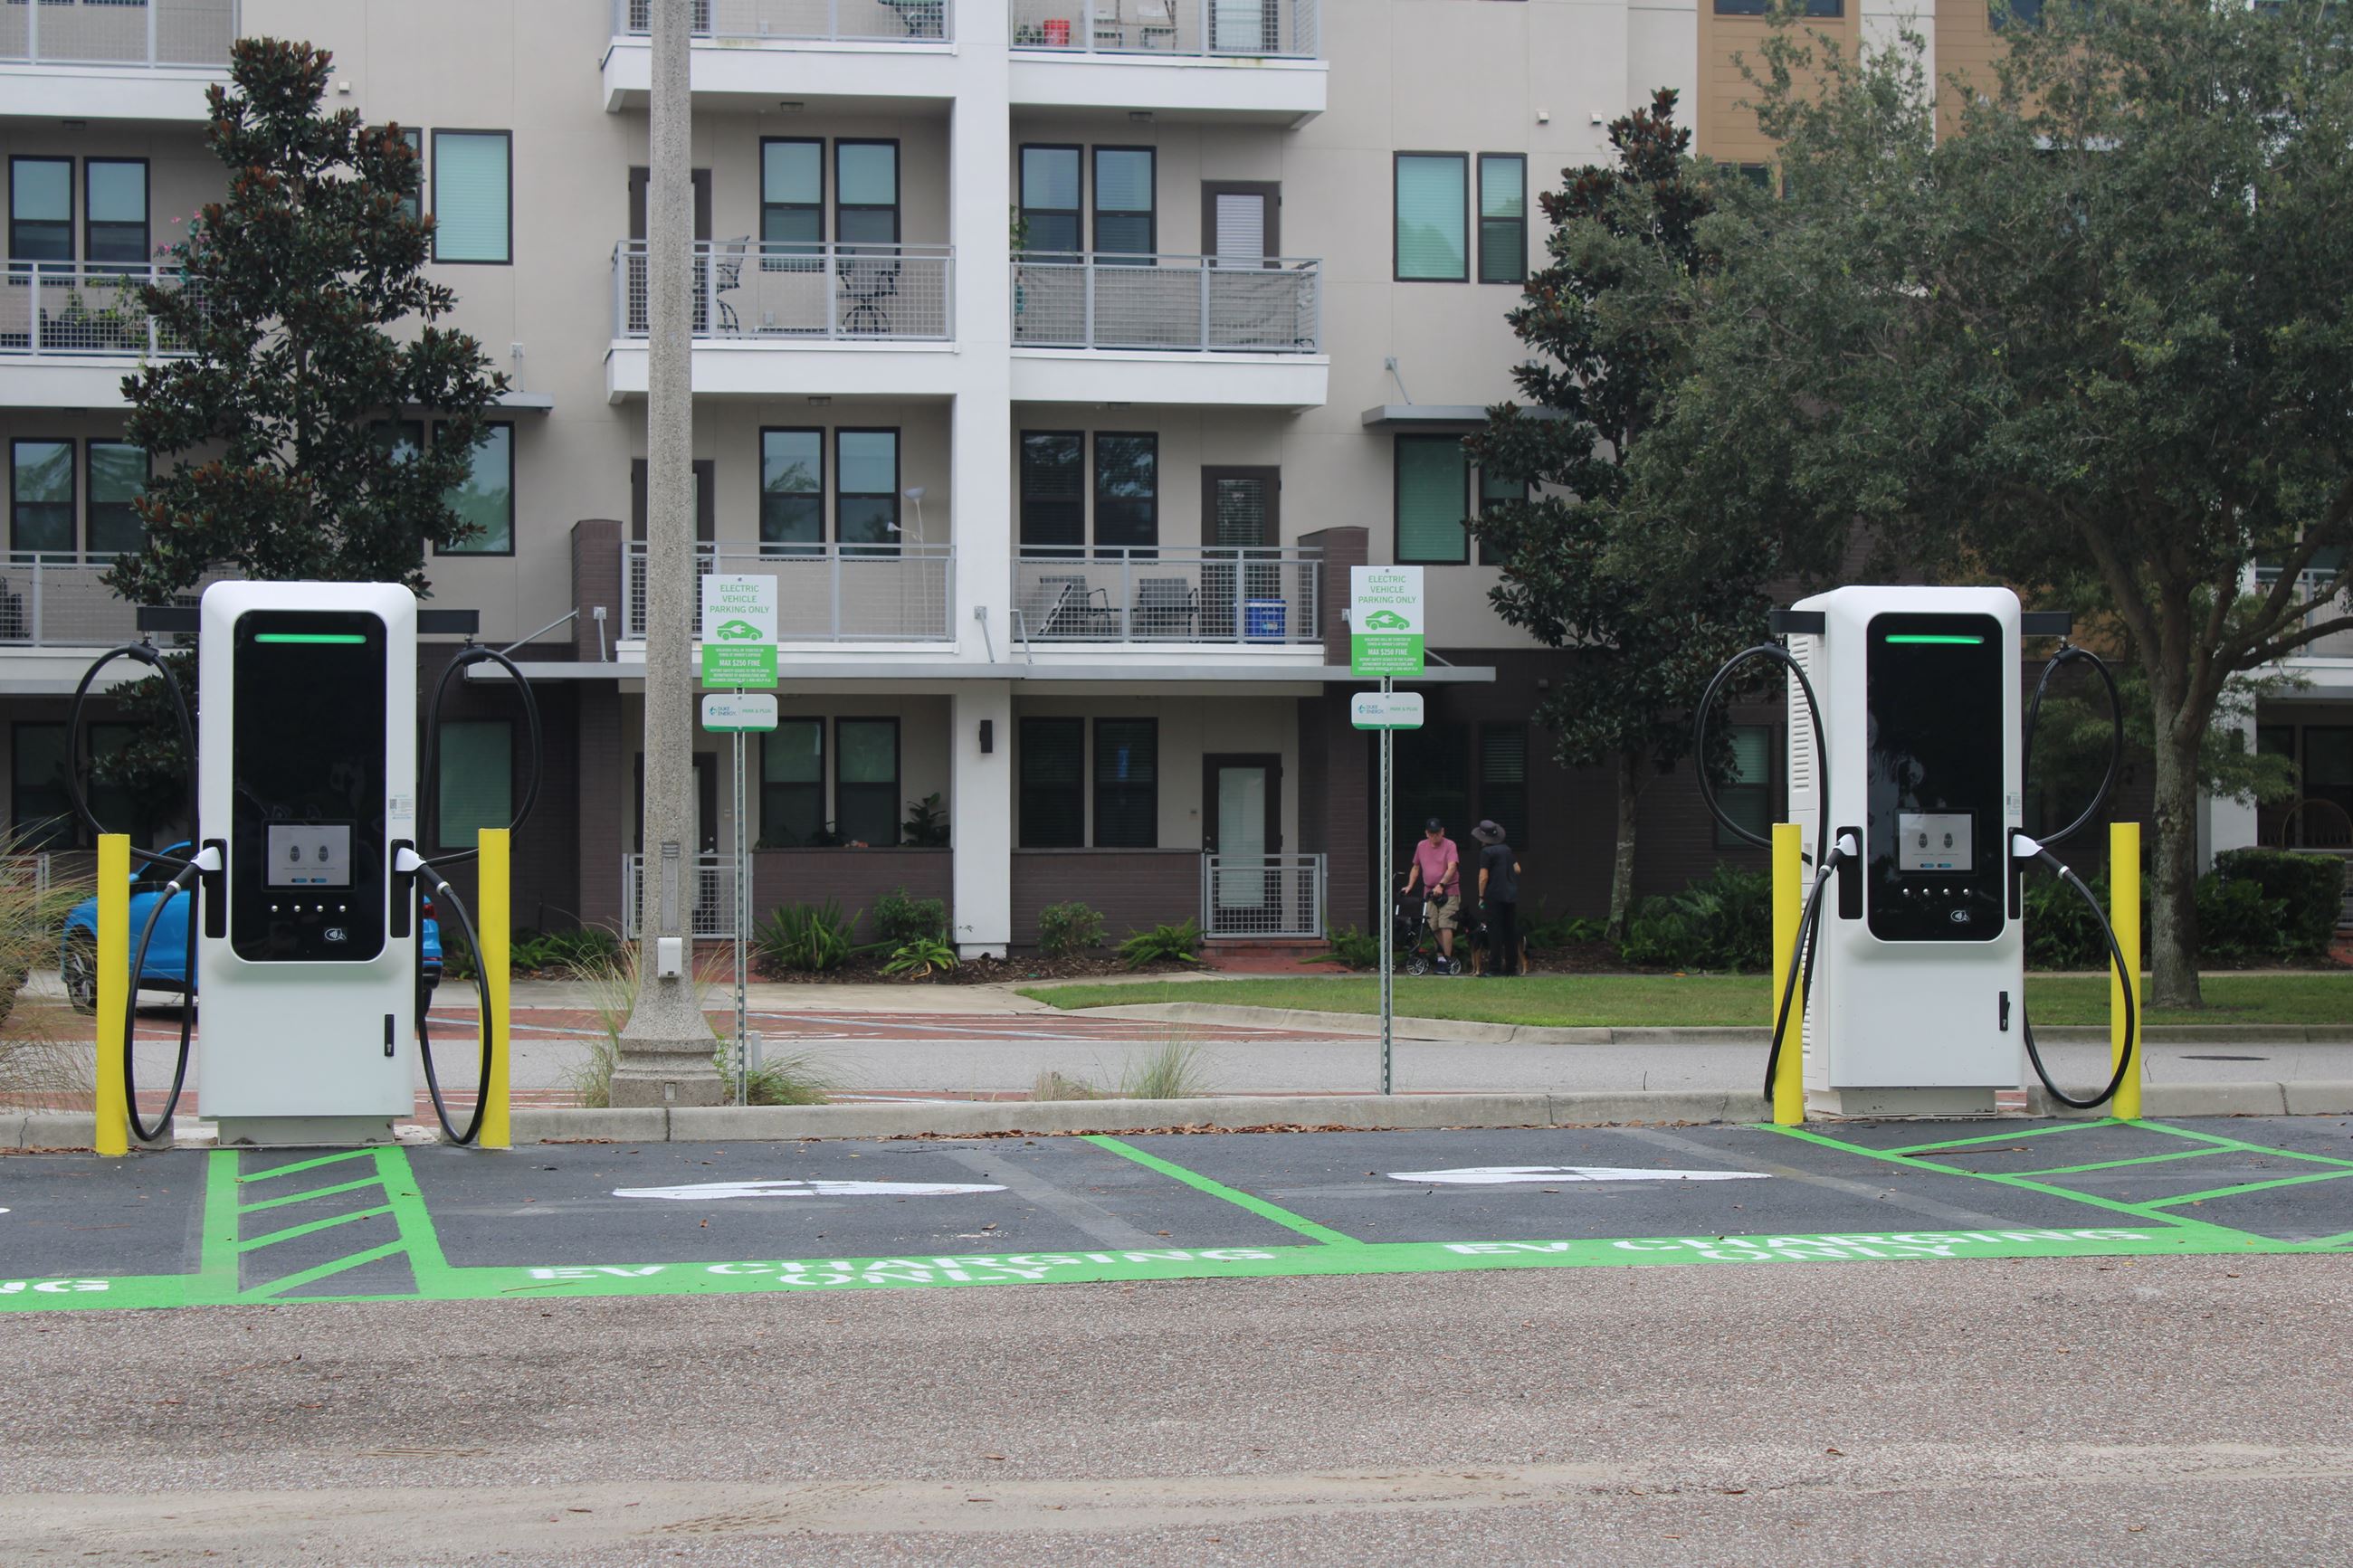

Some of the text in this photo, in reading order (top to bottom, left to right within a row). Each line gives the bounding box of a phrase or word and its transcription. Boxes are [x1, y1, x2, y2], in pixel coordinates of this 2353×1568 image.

[720, 584, 759, 593] ELECTRIC
[1358, 596, 1394, 604] PARKING
[710, 605, 769, 613] PARKING ONLY
[1443, 1231, 2151, 1254] EV CHARGING
[1697, 1245, 1956, 1259] ONLY
[529, 1250, 1274, 1279] EV CHARGING
[776, 1267, 1052, 1285] ONLY
